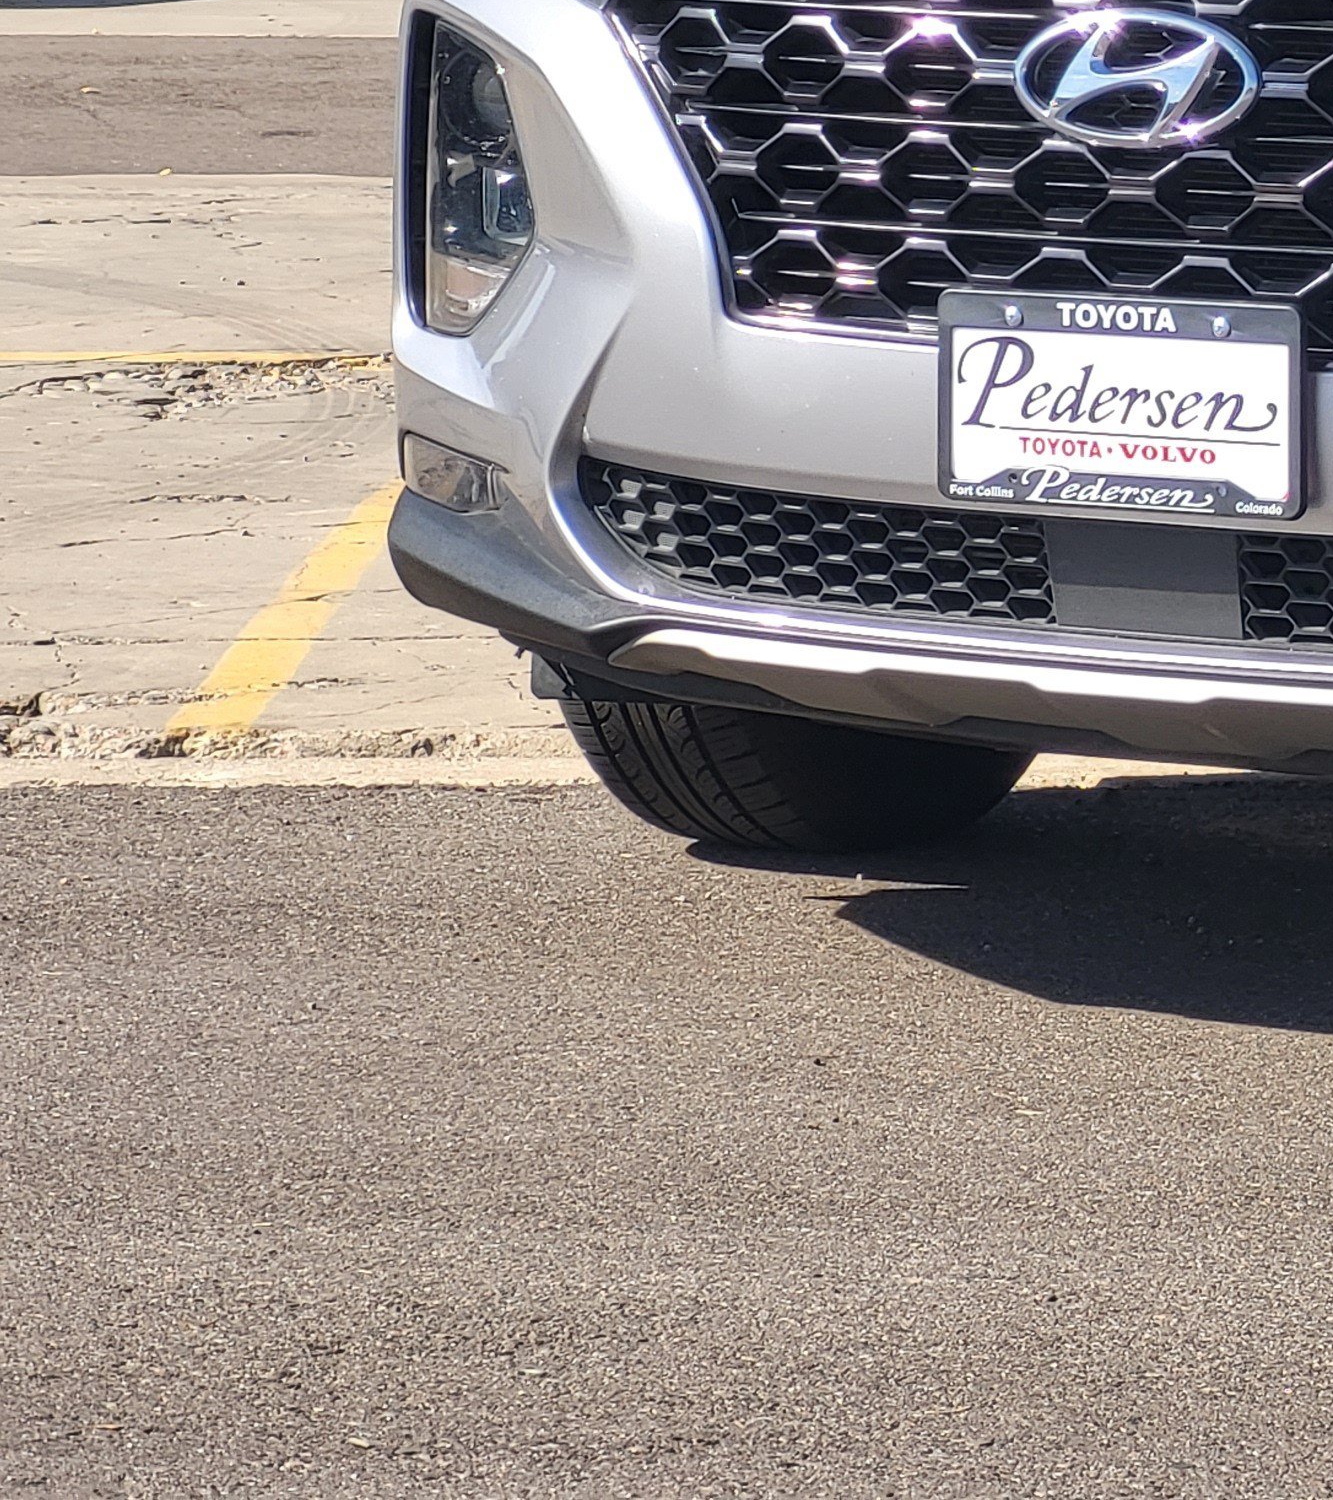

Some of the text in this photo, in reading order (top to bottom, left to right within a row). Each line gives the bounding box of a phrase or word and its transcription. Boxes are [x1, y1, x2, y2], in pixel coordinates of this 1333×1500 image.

[1056, 302, 1177, 332] TOYOTA
[957, 336, 1278, 432] Pedersen
[1019, 436, 1216, 465] TOYOTA VOLVO
[949, 484, 1014, 499] Fort Collins
[1021, 465, 1214, 507] Pedersen
[1235, 501, 1283, 516] Colorado
